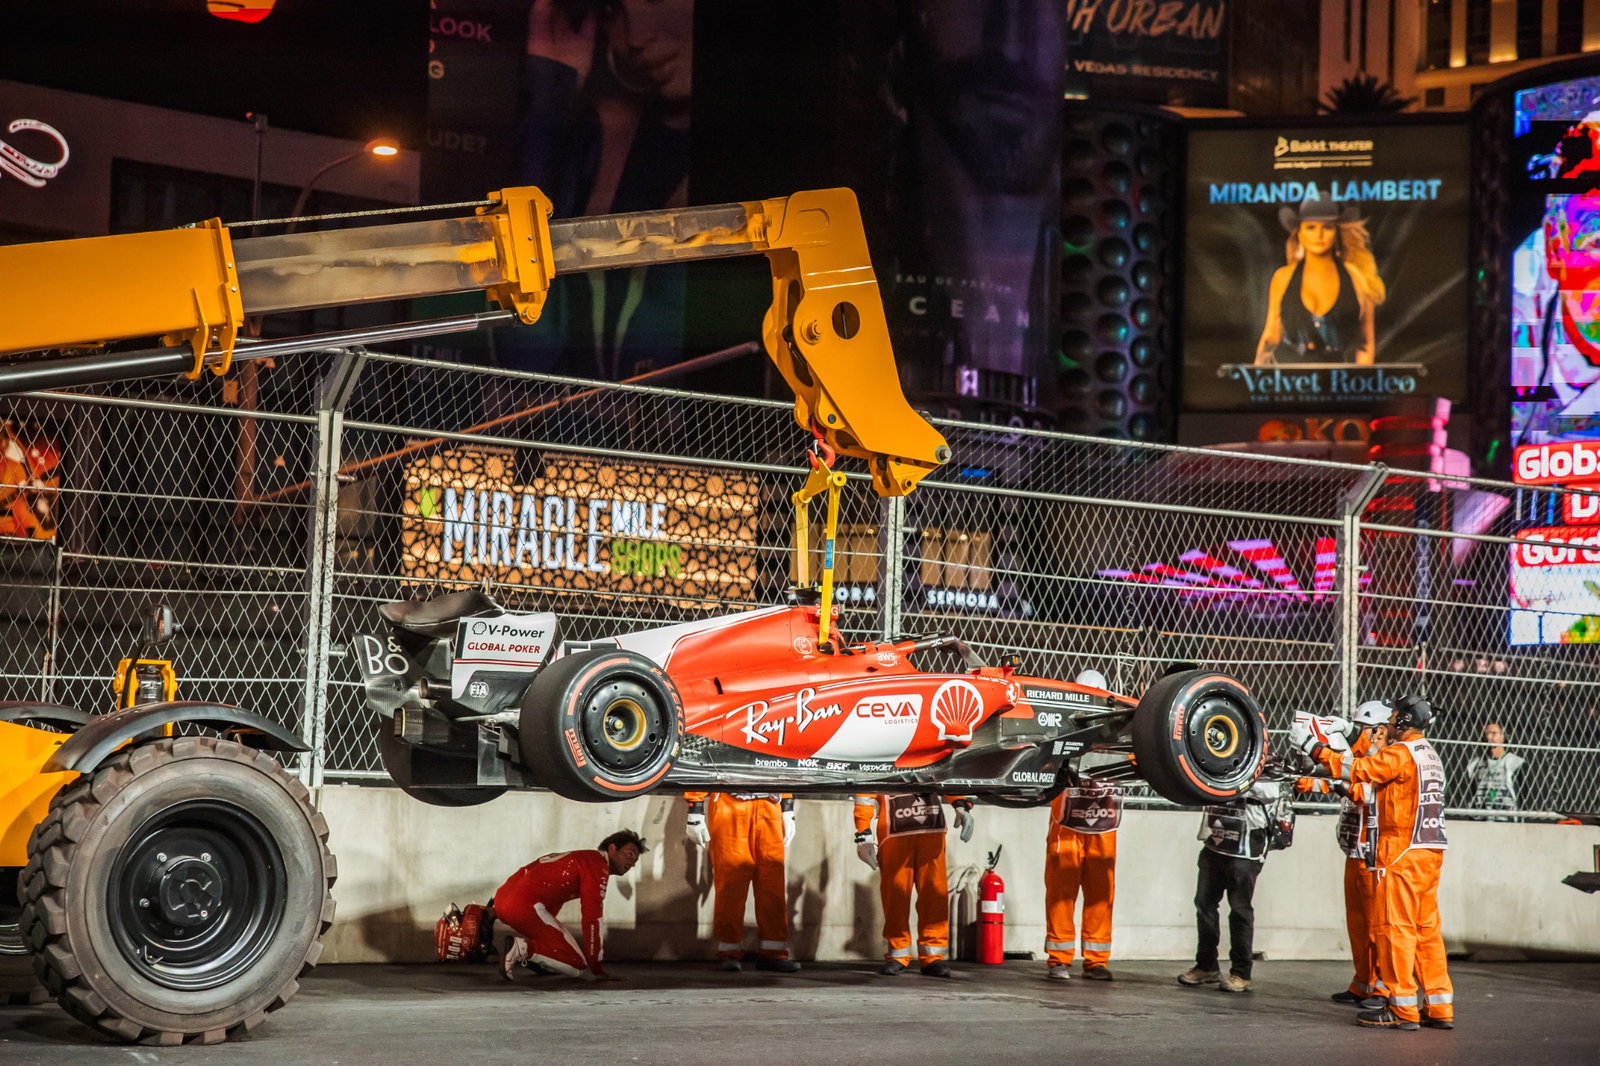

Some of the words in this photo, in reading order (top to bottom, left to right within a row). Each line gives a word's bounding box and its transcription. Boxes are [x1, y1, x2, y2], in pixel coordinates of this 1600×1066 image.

[1106, 0, 1225, 39] URBAN
[1074, 59, 1127, 75] VEGAS
[1132, 64, 1218, 81] RESIDENCY
[1329, 140, 1373, 151] THEATER
[1209, 181, 1320, 204] MIRANDA
[1331, 179, 1442, 201] LAMBERT
[1231, 365, 1322, 394] Velvet
[1330, 367, 1416, 394] Rodeo
[443, 488, 608, 572] MIRACLE
[611, 500, 667, 538] MILE
[611, 541, 682, 577] SHOPS
[927, 589, 1000, 609] SEPHORA
[488, 624, 545, 638] V-Power
[467, 642, 506, 652] GLOBAL
[508, 644, 541, 654] POKER
[877, 652, 896, 661] aws
[470, 684, 489, 696] FIA
[1026, 689, 1063, 700] RICHARD
[1065, 692, 1090, 703] MILLE
[755, 758, 788, 768] brembo
[797, 759, 820, 769] NGK
[825, 761, 850, 770] SKF
[1012, 771, 1039, 782] GLOBAL
[1039, 773, 1055, 783] POKER
[895, 805, 940, 819] COURSE
